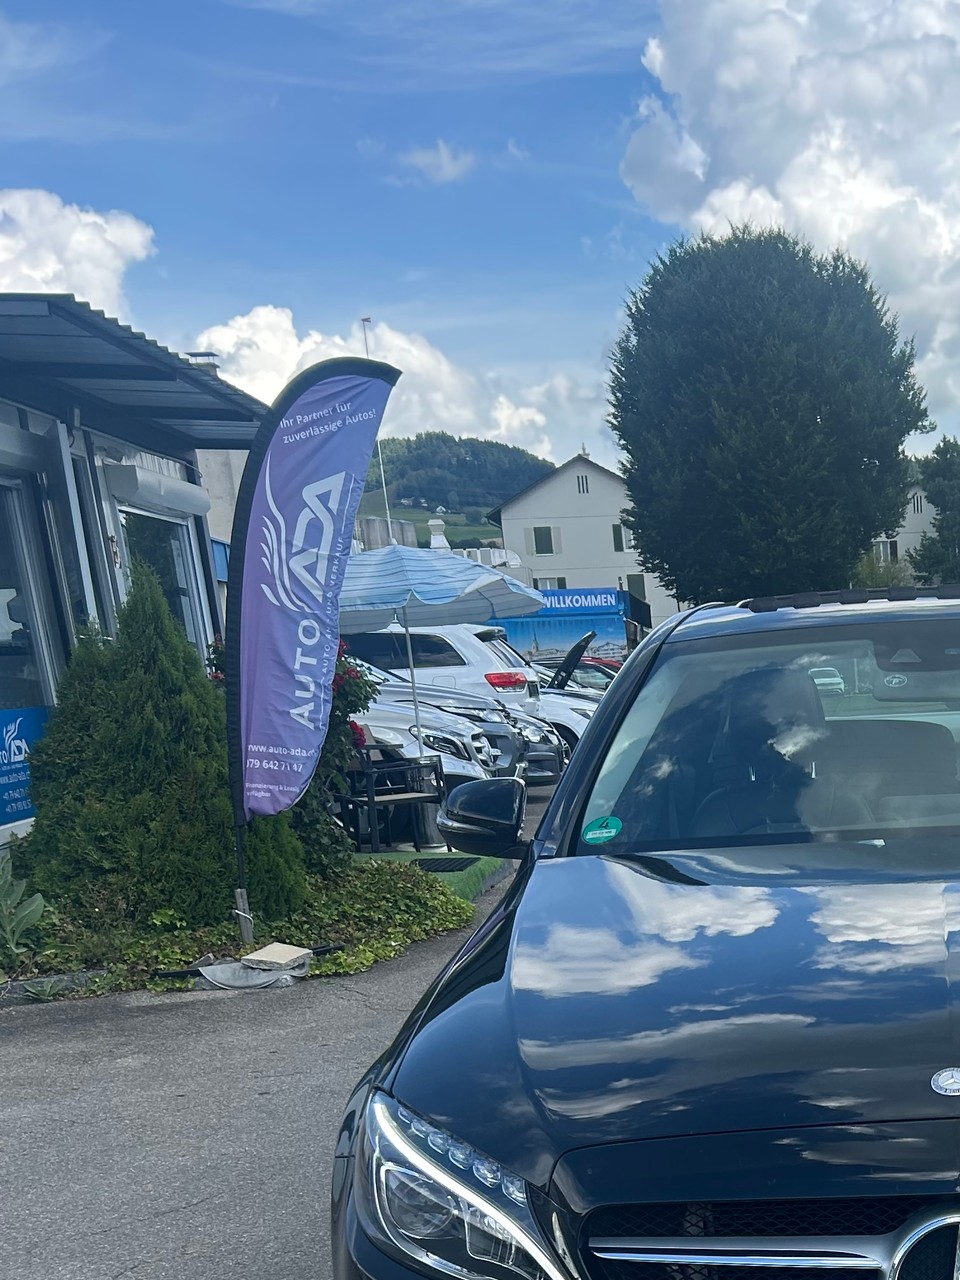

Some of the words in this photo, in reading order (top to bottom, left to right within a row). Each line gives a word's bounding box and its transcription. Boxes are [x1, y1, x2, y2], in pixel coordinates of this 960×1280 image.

[280, 418, 294, 428] Ihr
[296, 407, 333, 424] Partner
[336, 401, 351, 413] für
[283, 419, 343, 444] zuverlässige
[345, 408, 376, 425] Autos!
[288, 470, 345, 603] ADA
[321, 644, 331, 674] AUTO
[329, 536, 344, 586] VERKAUF
[542, 594, 616, 608] WILLKOMMEN
[289, 619, 320, 731] AUTO
[262, 760, 279, 770] 642
[280, 762, 290, 771] 71
[598, 817, 609, 829] 4
